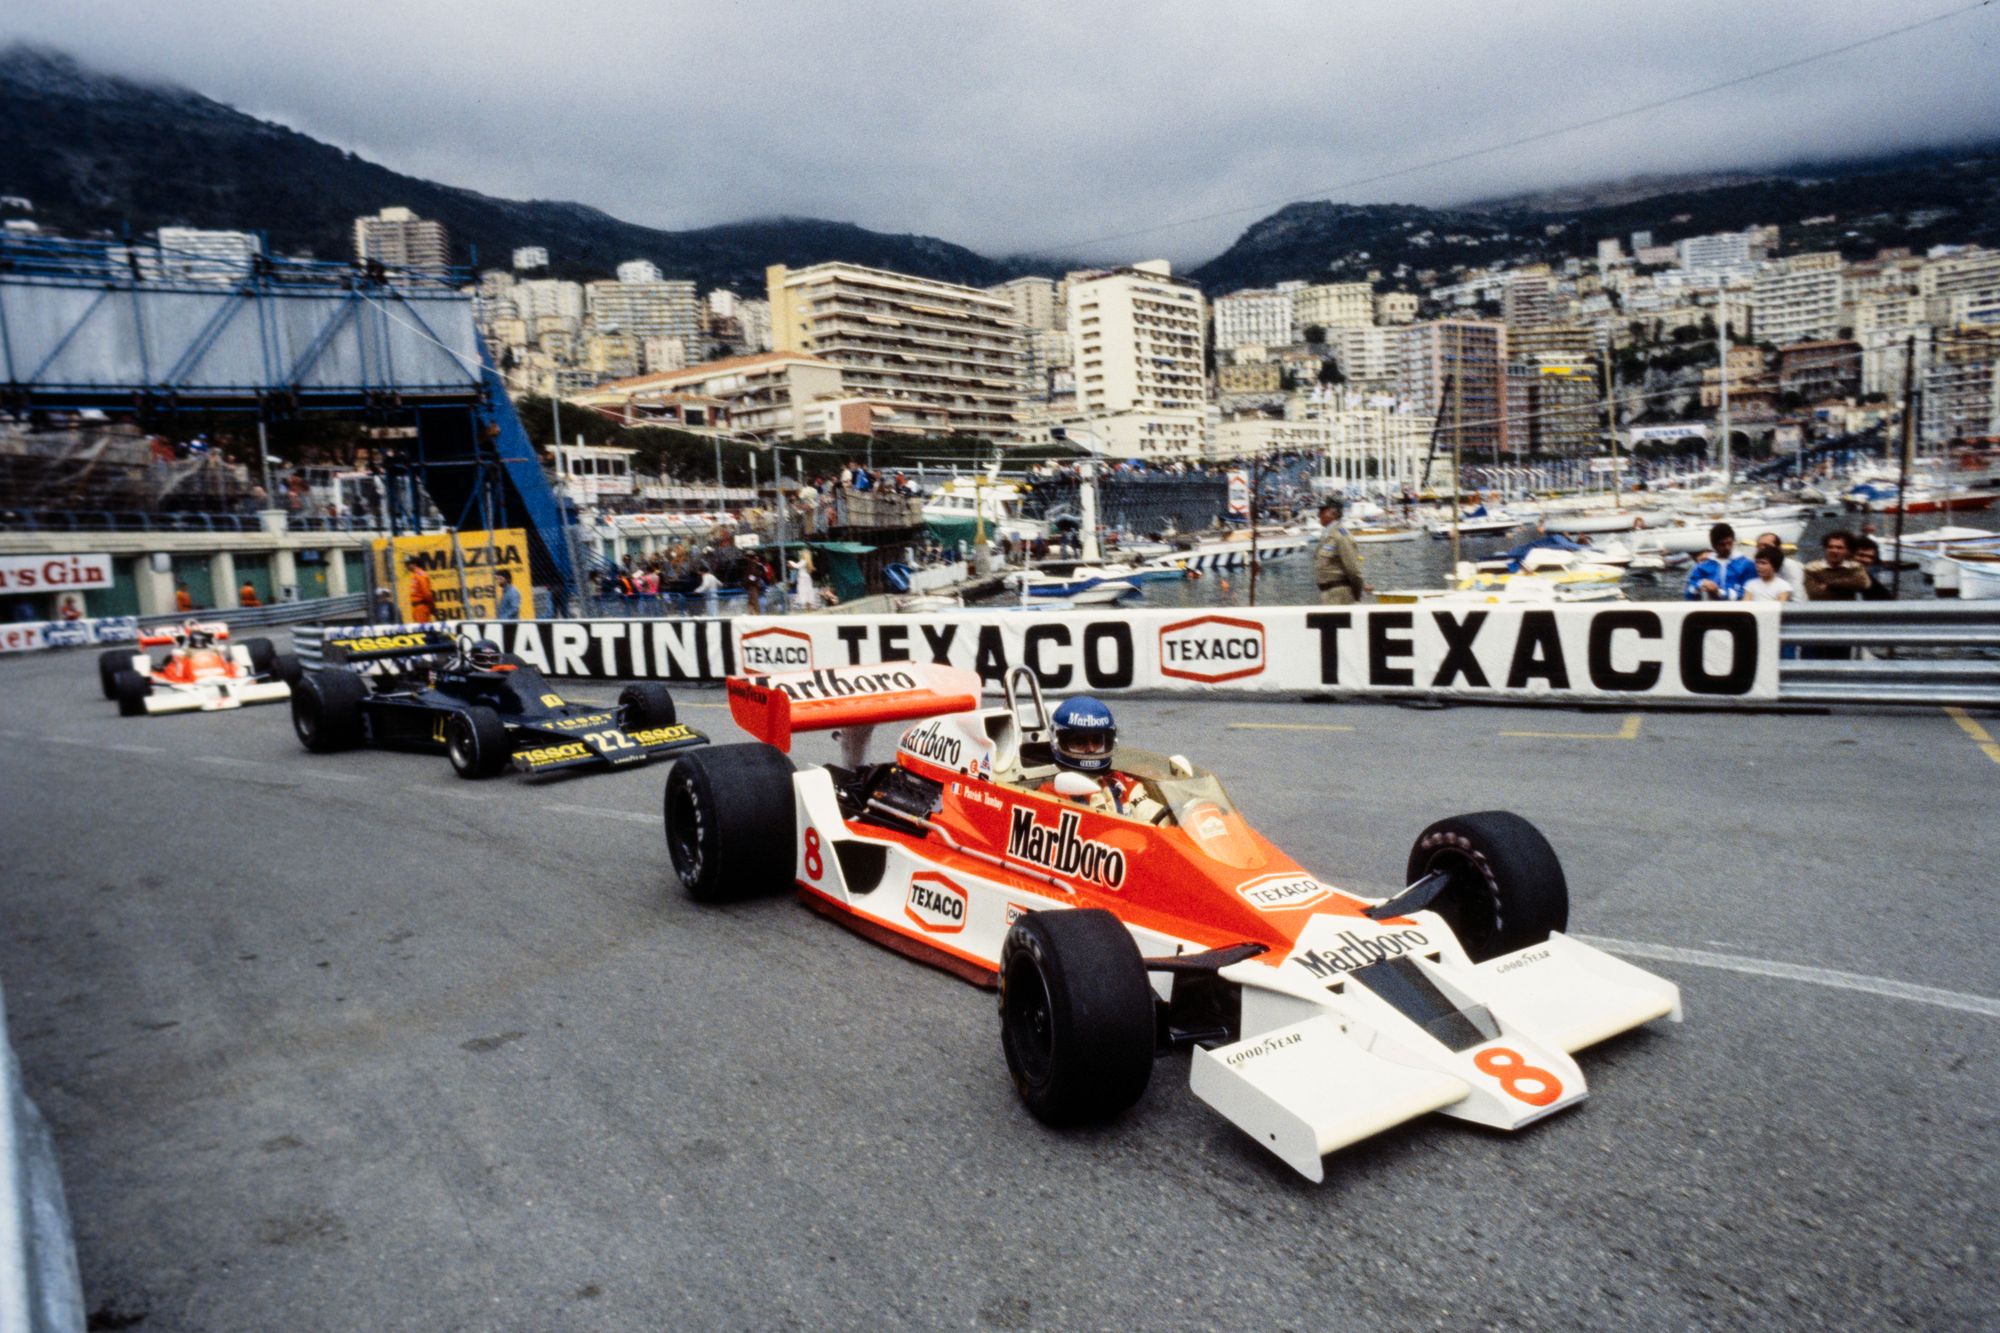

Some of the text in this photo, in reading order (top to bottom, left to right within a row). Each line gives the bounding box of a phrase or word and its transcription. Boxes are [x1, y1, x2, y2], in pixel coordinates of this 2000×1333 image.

[42, 556, 104, 585] Gin
[460, 620, 726, 677] MARTINI
[744, 645, 809, 665] TEXACO
[838, 621, 1134, 690] TEXACO
[1166, 638, 1259, 661] TEXACO
[1303, 610, 1759, 695] TEXACO
[1068, 712, 1110, 727] Marlboro
[584, 729, 637, 752] 22
[805, 827, 823, 881] 8
[1007, 806, 1125, 889] Marlboro
[911, 884, 963, 920] TEXACO
[1251, 880, 1318, 904] TEXACO
[1292, 929, 1429, 979] Marlboro
[1226, 1032, 1303, 1065] GOODYEAR
[1473, 1047, 1564, 1107] 8
